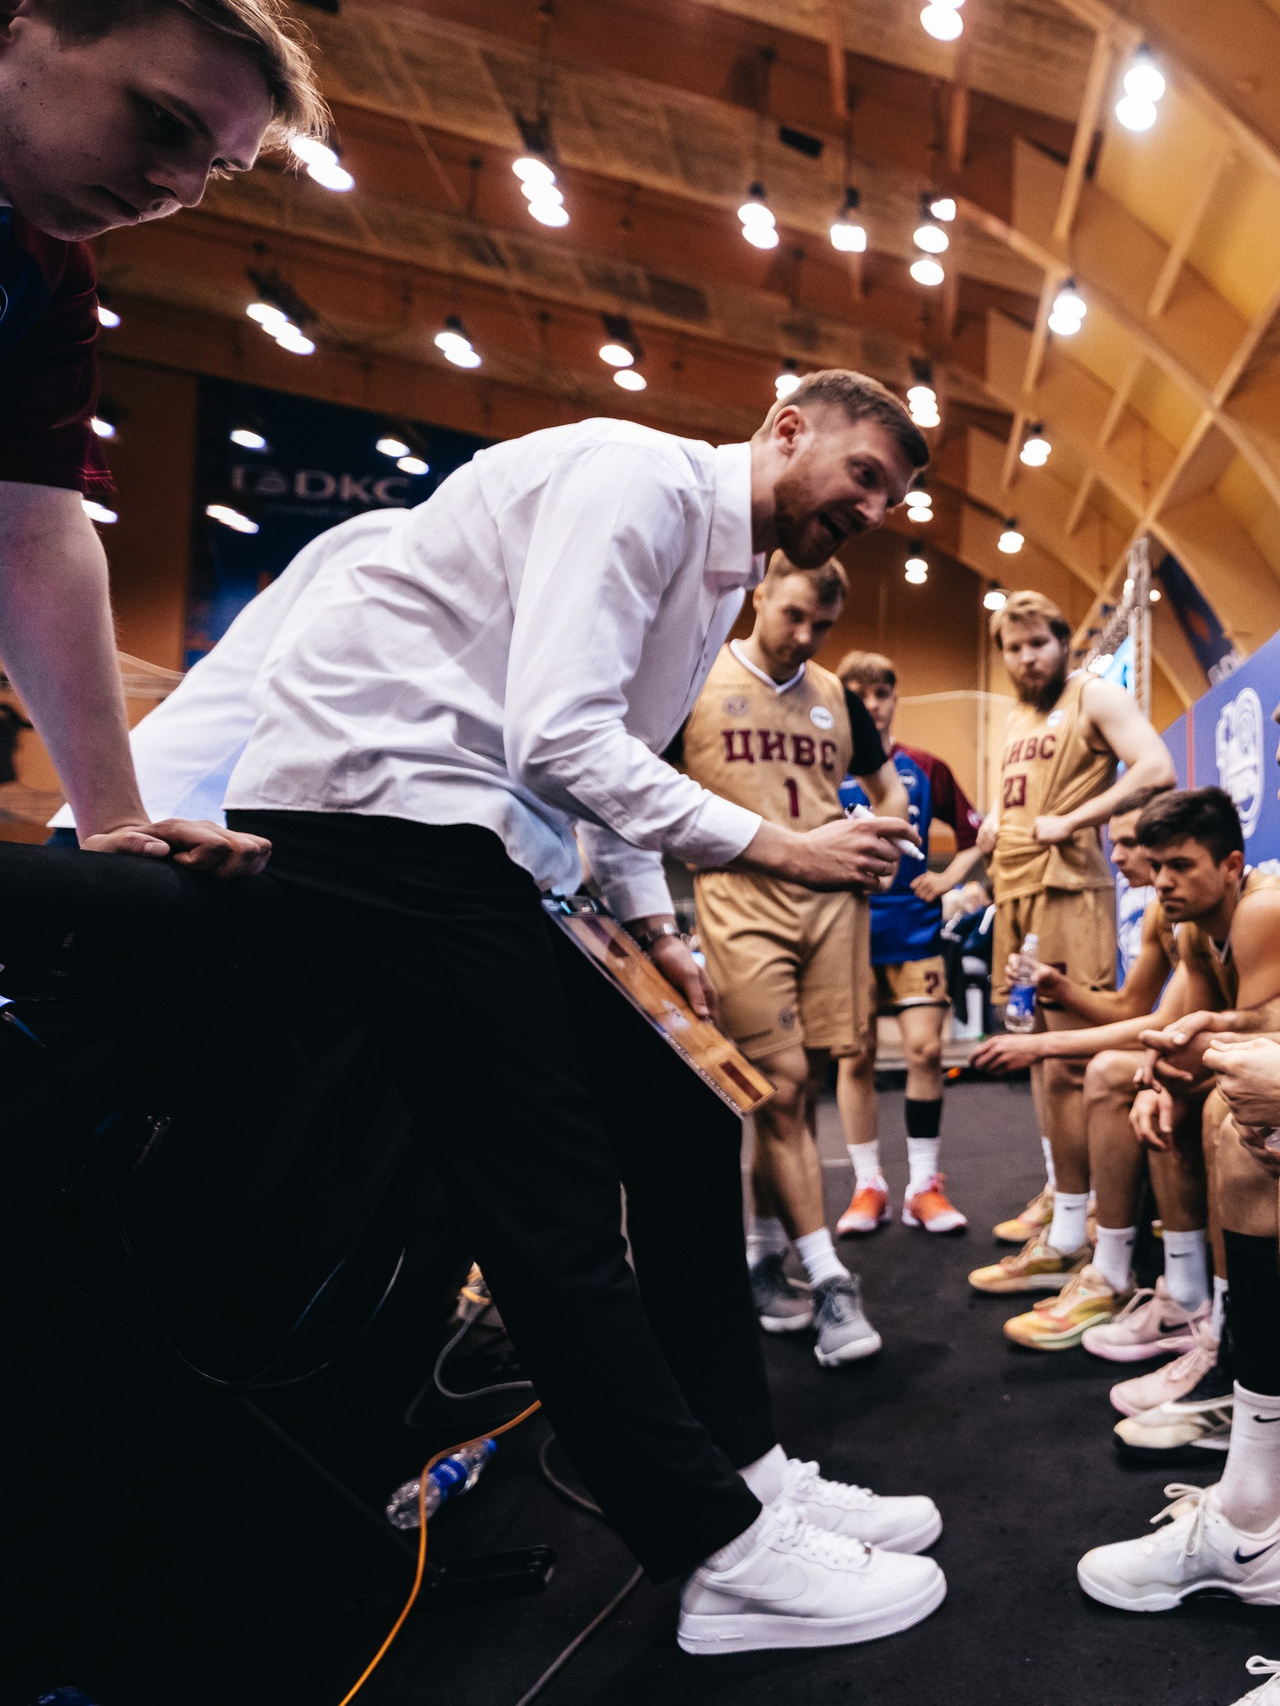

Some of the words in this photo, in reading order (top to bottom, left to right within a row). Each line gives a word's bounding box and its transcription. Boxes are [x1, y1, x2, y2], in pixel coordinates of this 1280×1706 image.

[294, 469, 411, 506] DKC
[721, 728, 838, 772] ЦИВС
[784, 777, 800, 818] 1
